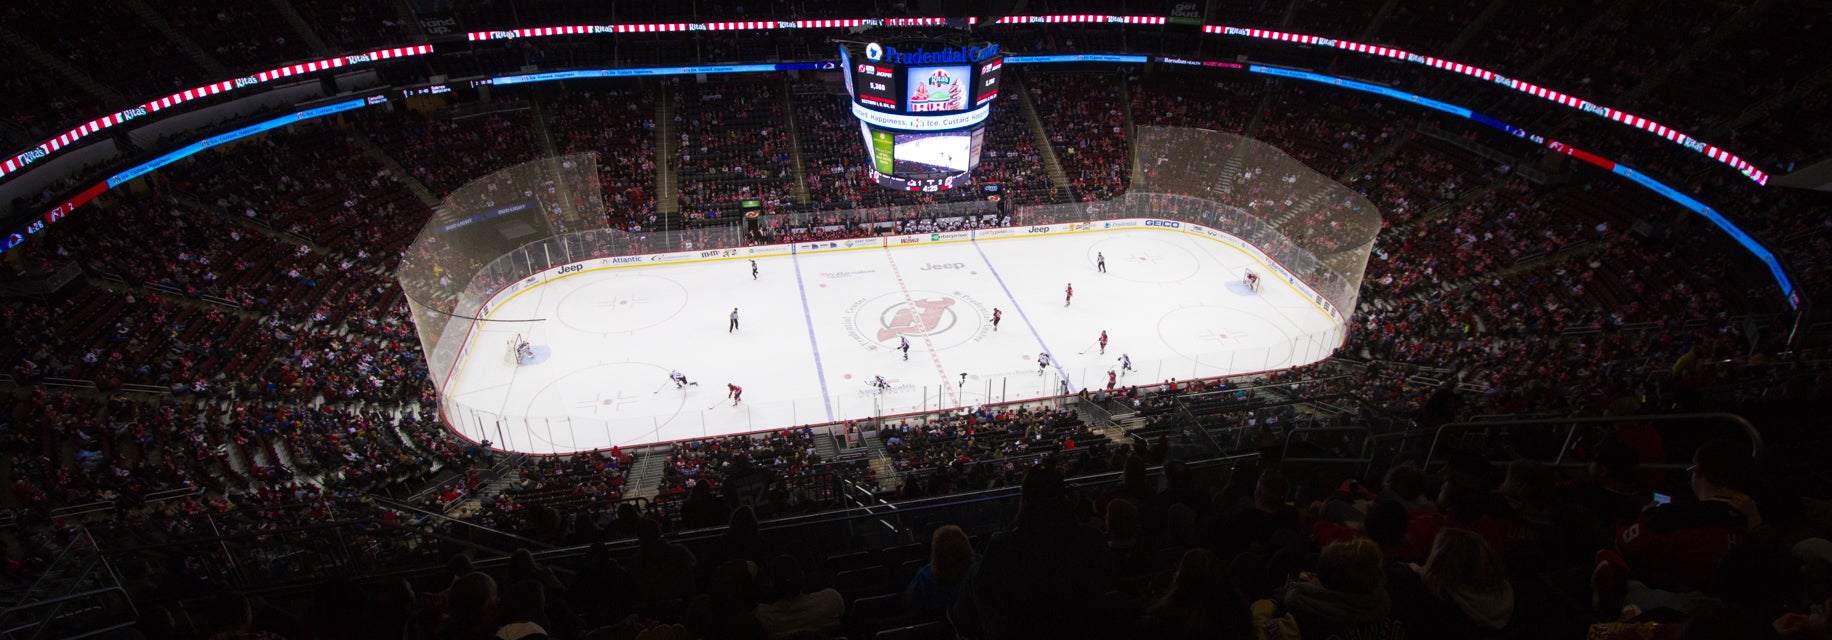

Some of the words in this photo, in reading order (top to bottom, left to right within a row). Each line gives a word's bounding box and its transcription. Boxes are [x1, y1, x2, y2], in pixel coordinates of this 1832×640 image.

[885, 46, 967, 64] Prudential
[970, 43, 1000, 61] Center
[870, 114, 908, 126] Happiness.
[943, 115, 970, 126] Custard.
[68, 202, 74, 211] 2
[1145, 220, 1179, 228] GEICO
[1029, 226, 1049, 234] Jeep
[558, 263, 583, 274] Jeep
[920, 262, 965, 271] Jeep
